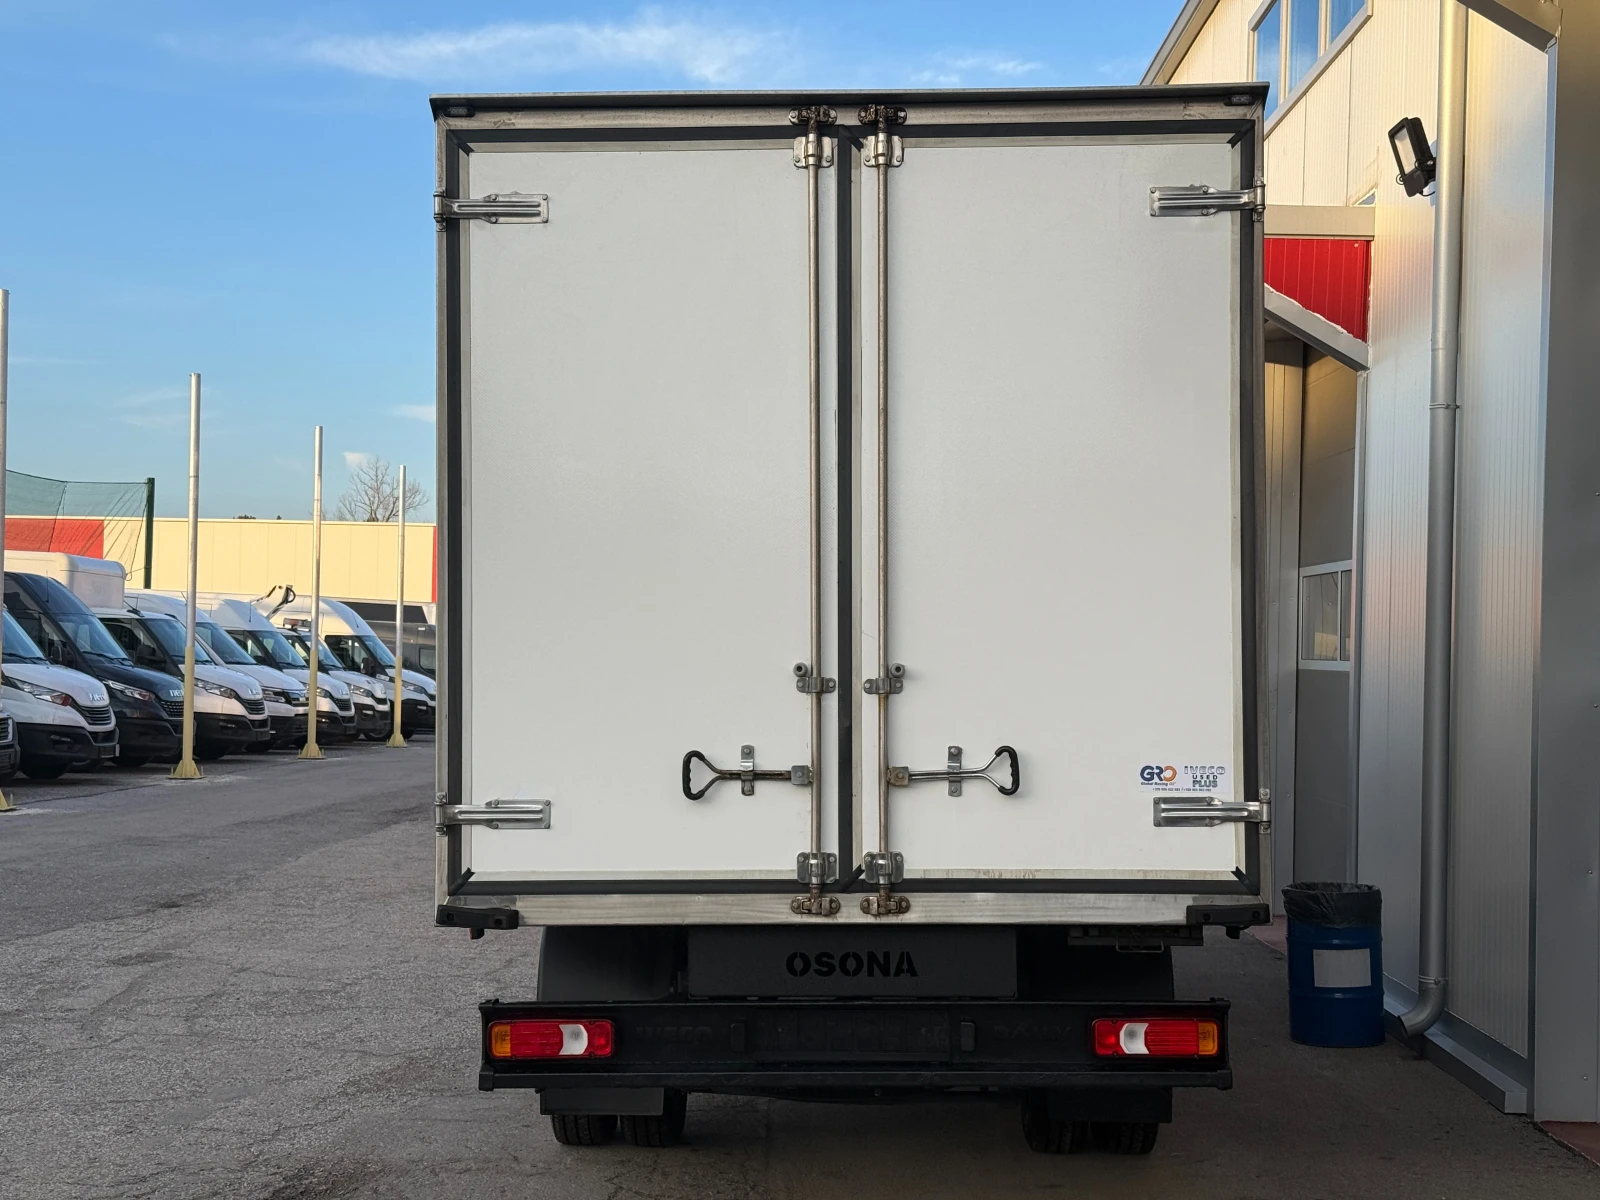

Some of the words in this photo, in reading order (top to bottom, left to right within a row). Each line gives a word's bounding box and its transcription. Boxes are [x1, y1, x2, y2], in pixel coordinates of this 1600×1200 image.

[1140, 765, 1177, 781] GRO
[1184, 765, 1226, 775] IVECO
[1192, 779, 1218, 788] PLUS
[785, 951, 919, 978] OSONA
